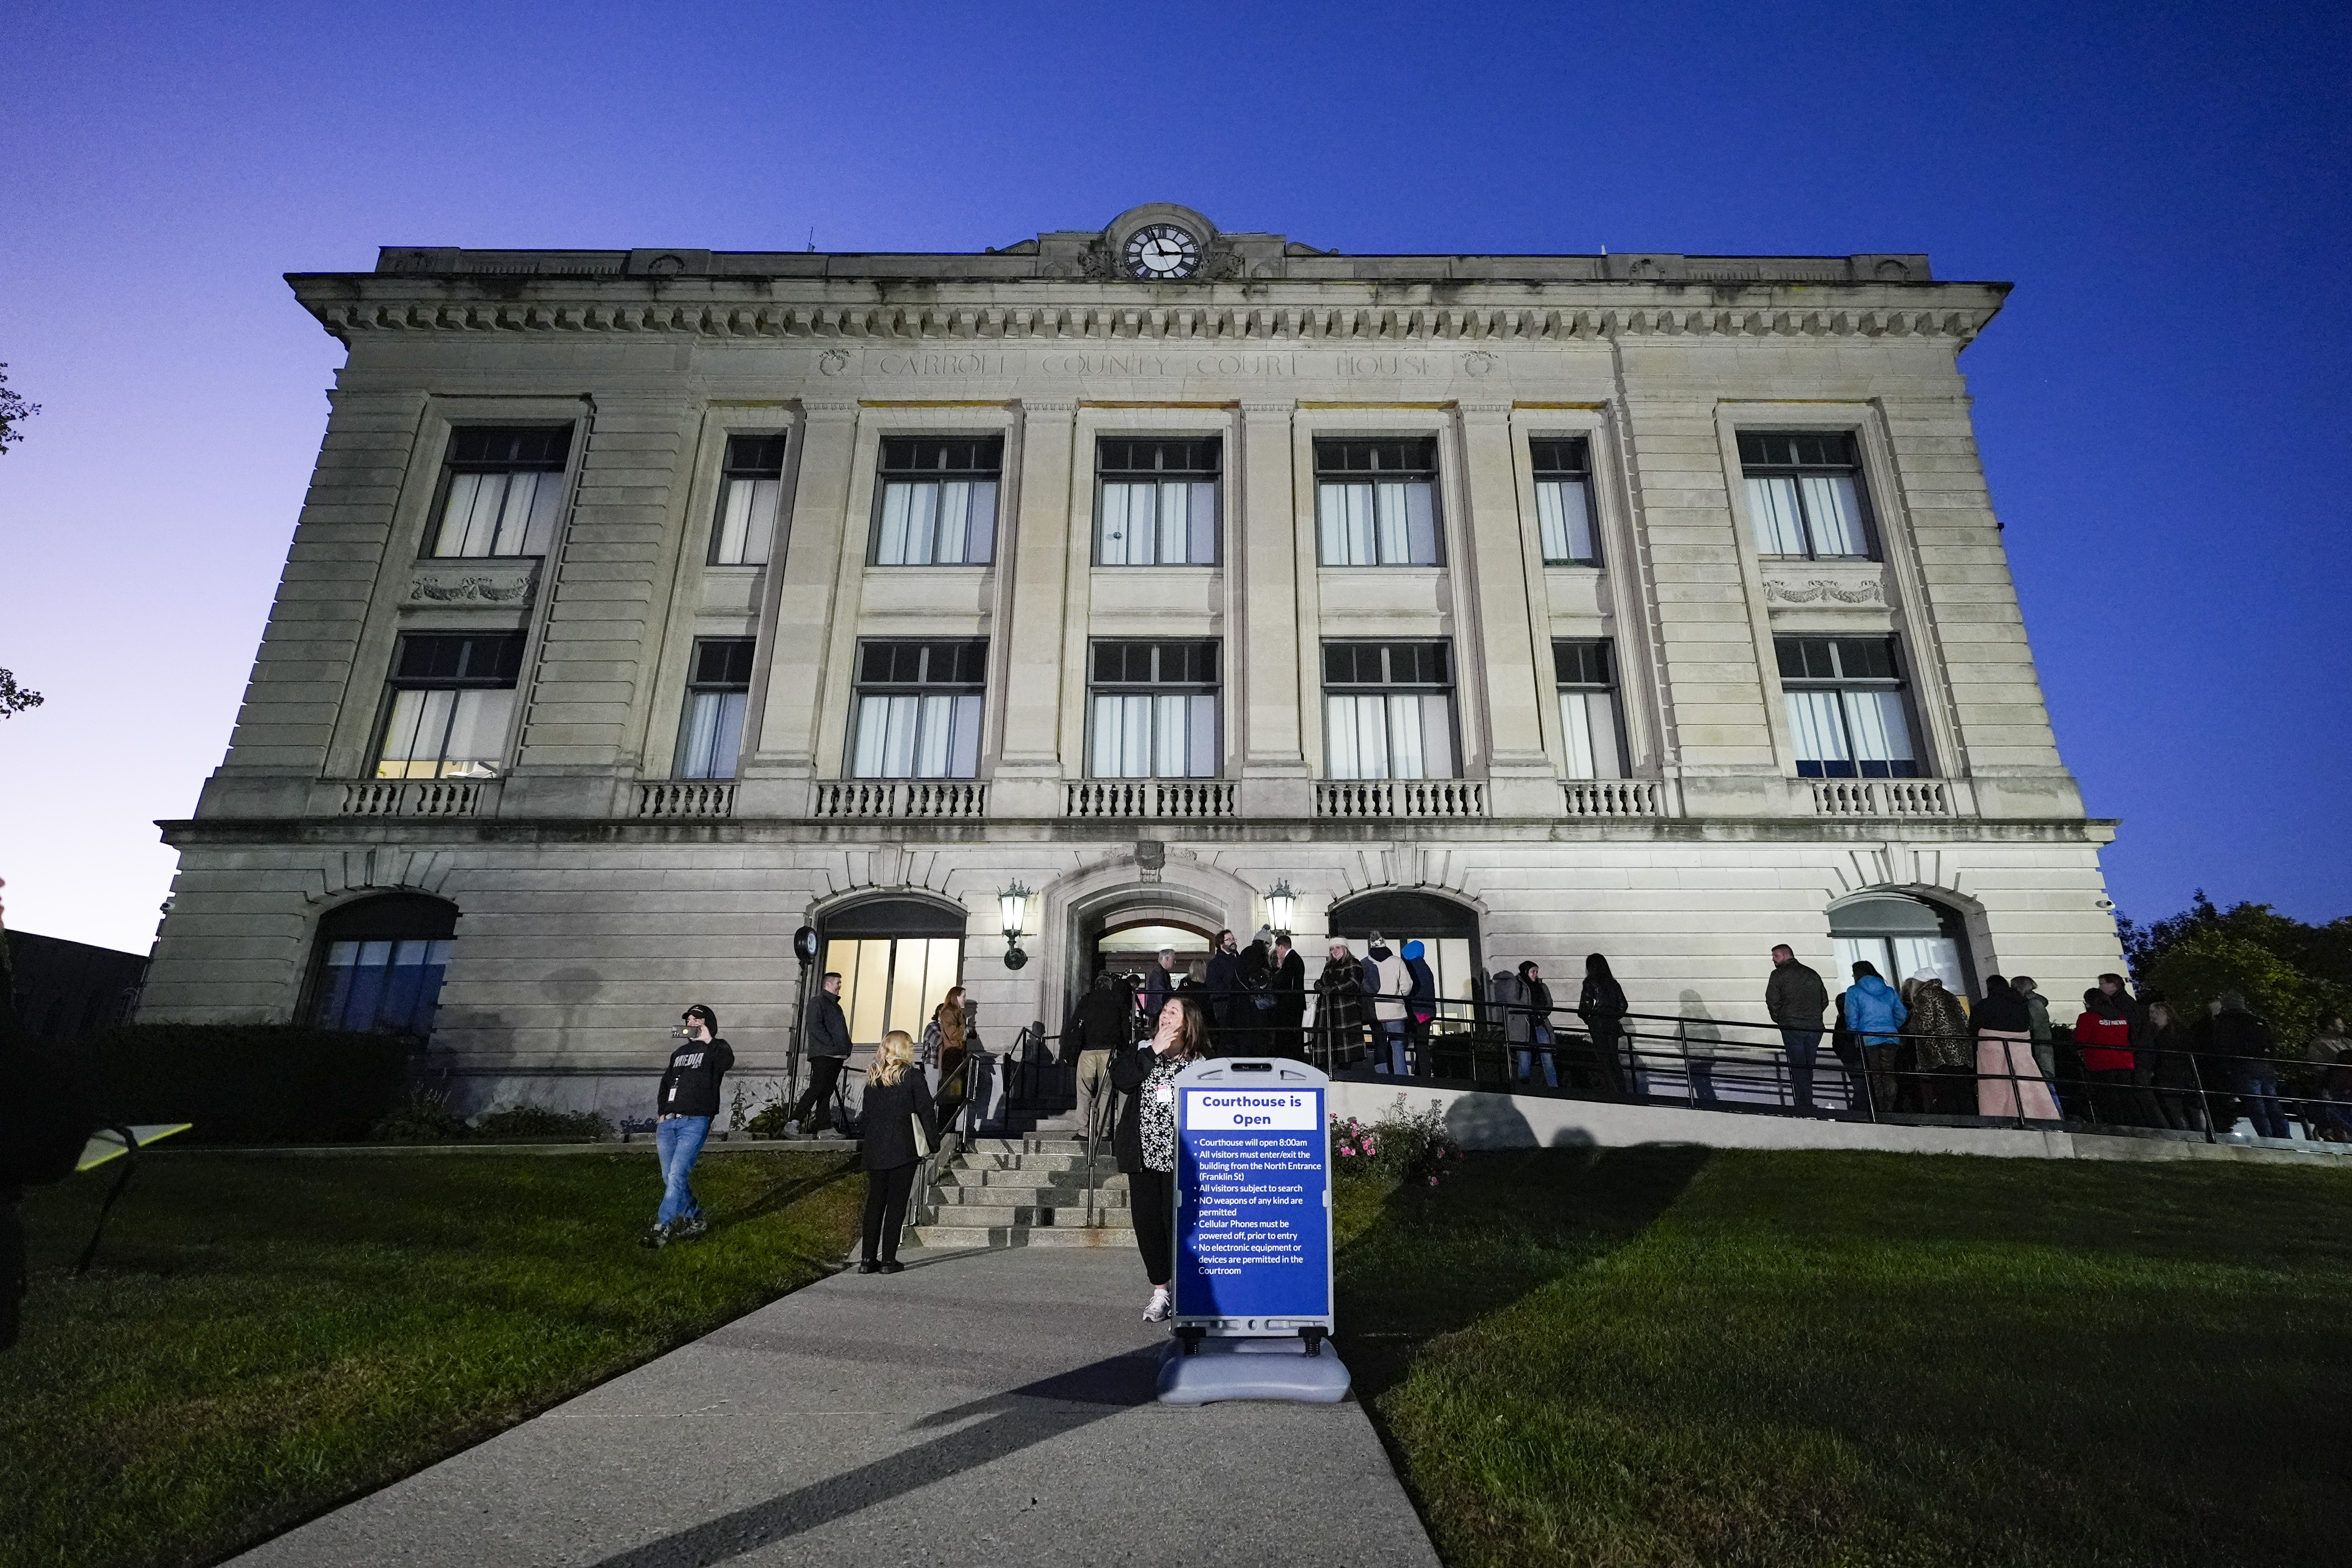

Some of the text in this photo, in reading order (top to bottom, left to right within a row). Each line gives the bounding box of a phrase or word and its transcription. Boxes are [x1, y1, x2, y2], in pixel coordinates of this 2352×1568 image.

[1042, 355, 1169, 375] COUNTY
[1197, 355, 1302, 375] COURT
[673, 1052, 704, 1067] MEDIA
[1203, 1095, 1301, 1107] Courthouse is
[1233, 1114, 1271, 1127] Open
[1200, 1162, 1229, 1171] building
[1200, 1173, 1244, 1181] (Franklin St)
[1240, 1184, 1267, 1193] subject
[1199, 1209, 1236, 1217] permitted
[1199, 1232, 1232, 1241] powered
[1234, 1232, 1246, 1240] off,
[1247, 1232, 1266, 1241] prior
[1277, 1232, 1297, 1240] entry
[1251, 1244, 1292, 1252] equipment
[1243, 1256, 1280, 1265] permitted
